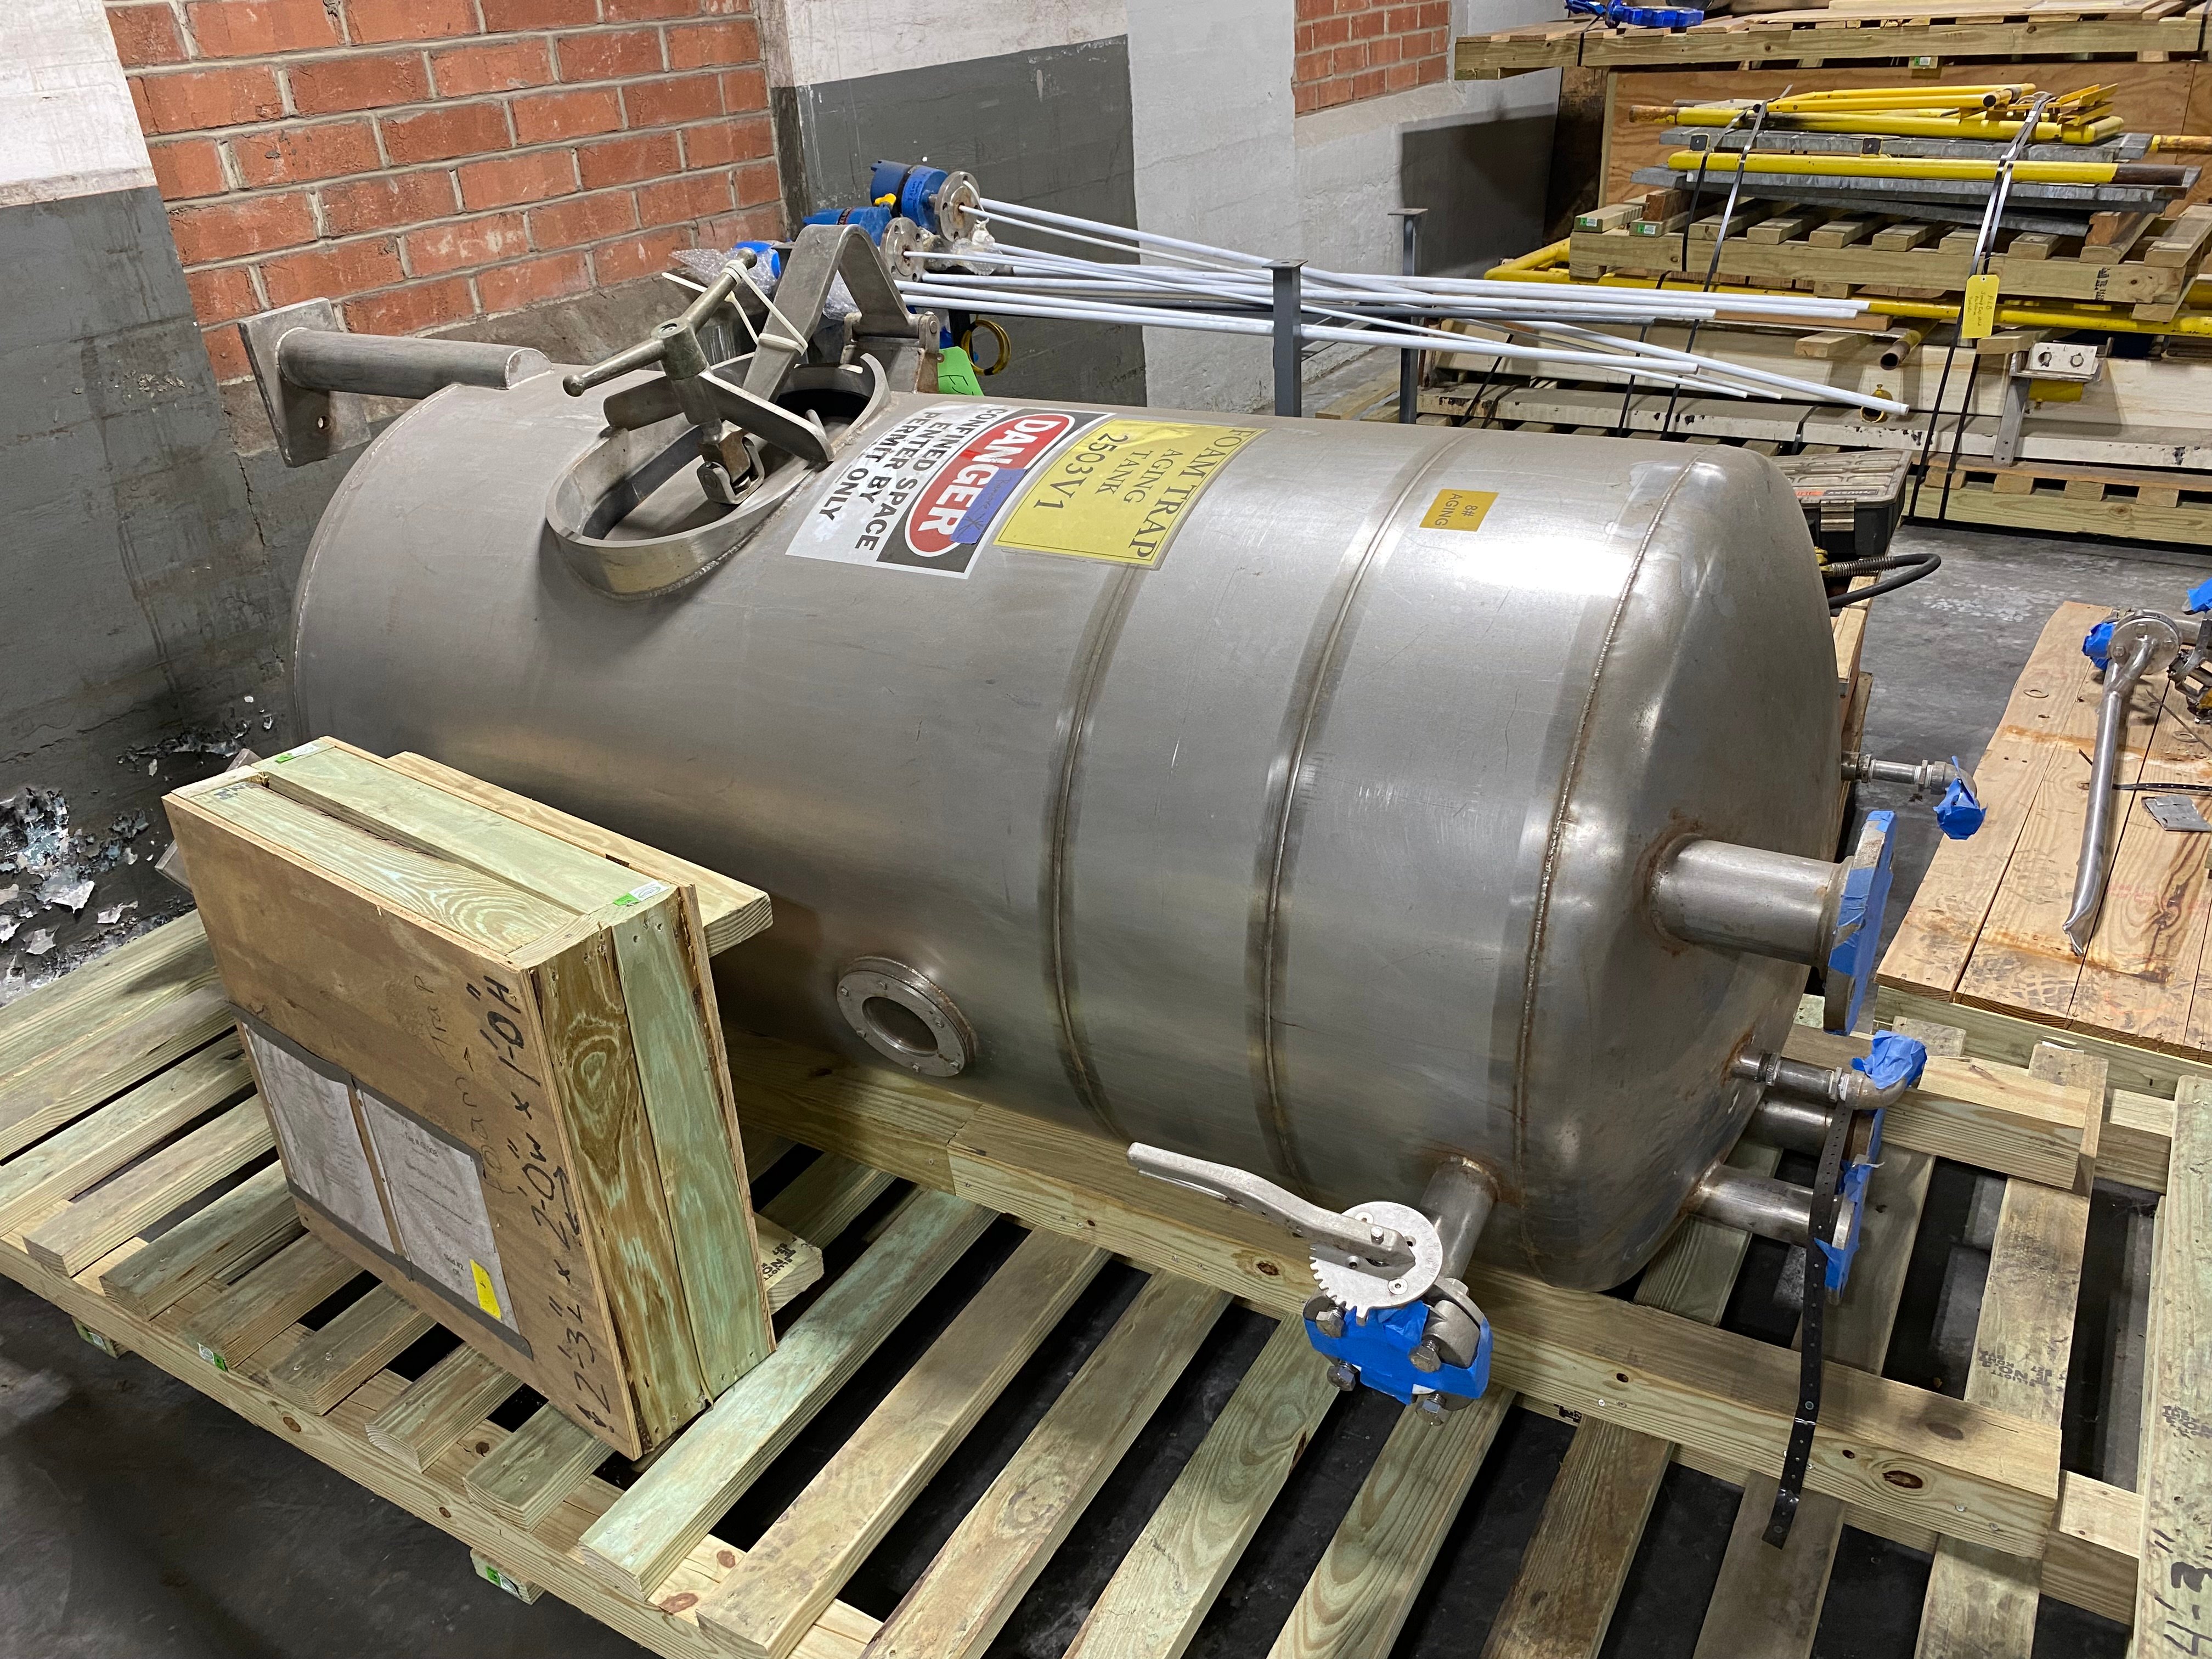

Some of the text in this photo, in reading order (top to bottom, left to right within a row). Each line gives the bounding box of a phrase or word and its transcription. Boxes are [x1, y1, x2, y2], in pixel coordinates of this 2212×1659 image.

[819, 412, 942, 521] PERMIT ONLY
[858, 422, 950, 504] ENTER BY
[912, 408, 1007, 472] CONFINED
[1033, 432, 1128, 510] 2503V1
[1094, 450, 1154, 495] TANK
[1123, 448, 1184, 504] AGING
[855, 477, 918, 551] SPACE
[918, 419, 1062, 536] DANGER
[1128, 428, 1257, 558] FOAM TRAP
[1434, 493, 1463, 526] AGING
[1462, 505, 1478, 517] 8#
